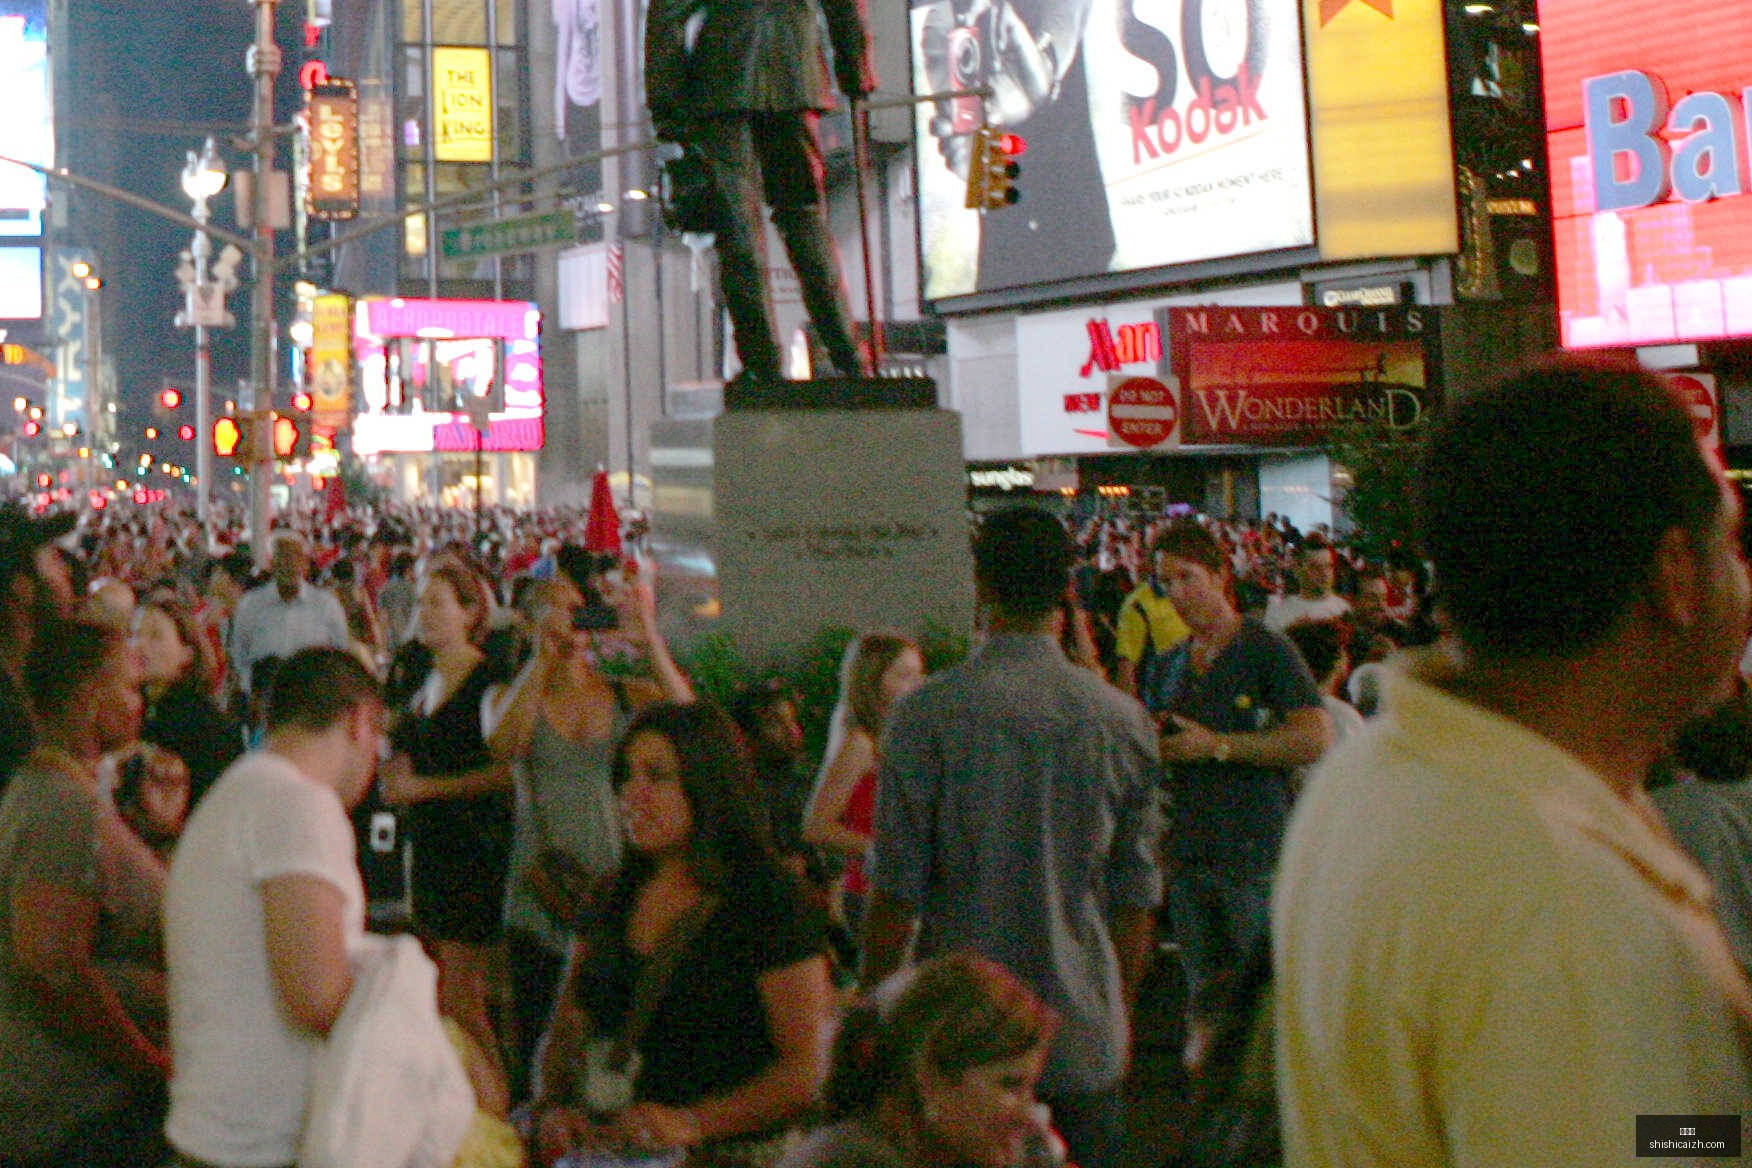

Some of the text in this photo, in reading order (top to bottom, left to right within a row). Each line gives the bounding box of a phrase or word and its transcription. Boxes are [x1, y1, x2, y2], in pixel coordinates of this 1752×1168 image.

[447, 69, 476, 85] THE
[441, 89, 484, 115] LION
[1129, 63, 1269, 165] Kodak
[441, 119, 486, 145] KING
[1184, 310, 1424, 335] MARQUIS
[1119, 389, 1165, 402] DO NOT
[1195, 387, 1424, 432] WONDERLAND
[1121, 421, 1162, 435] ENTER
